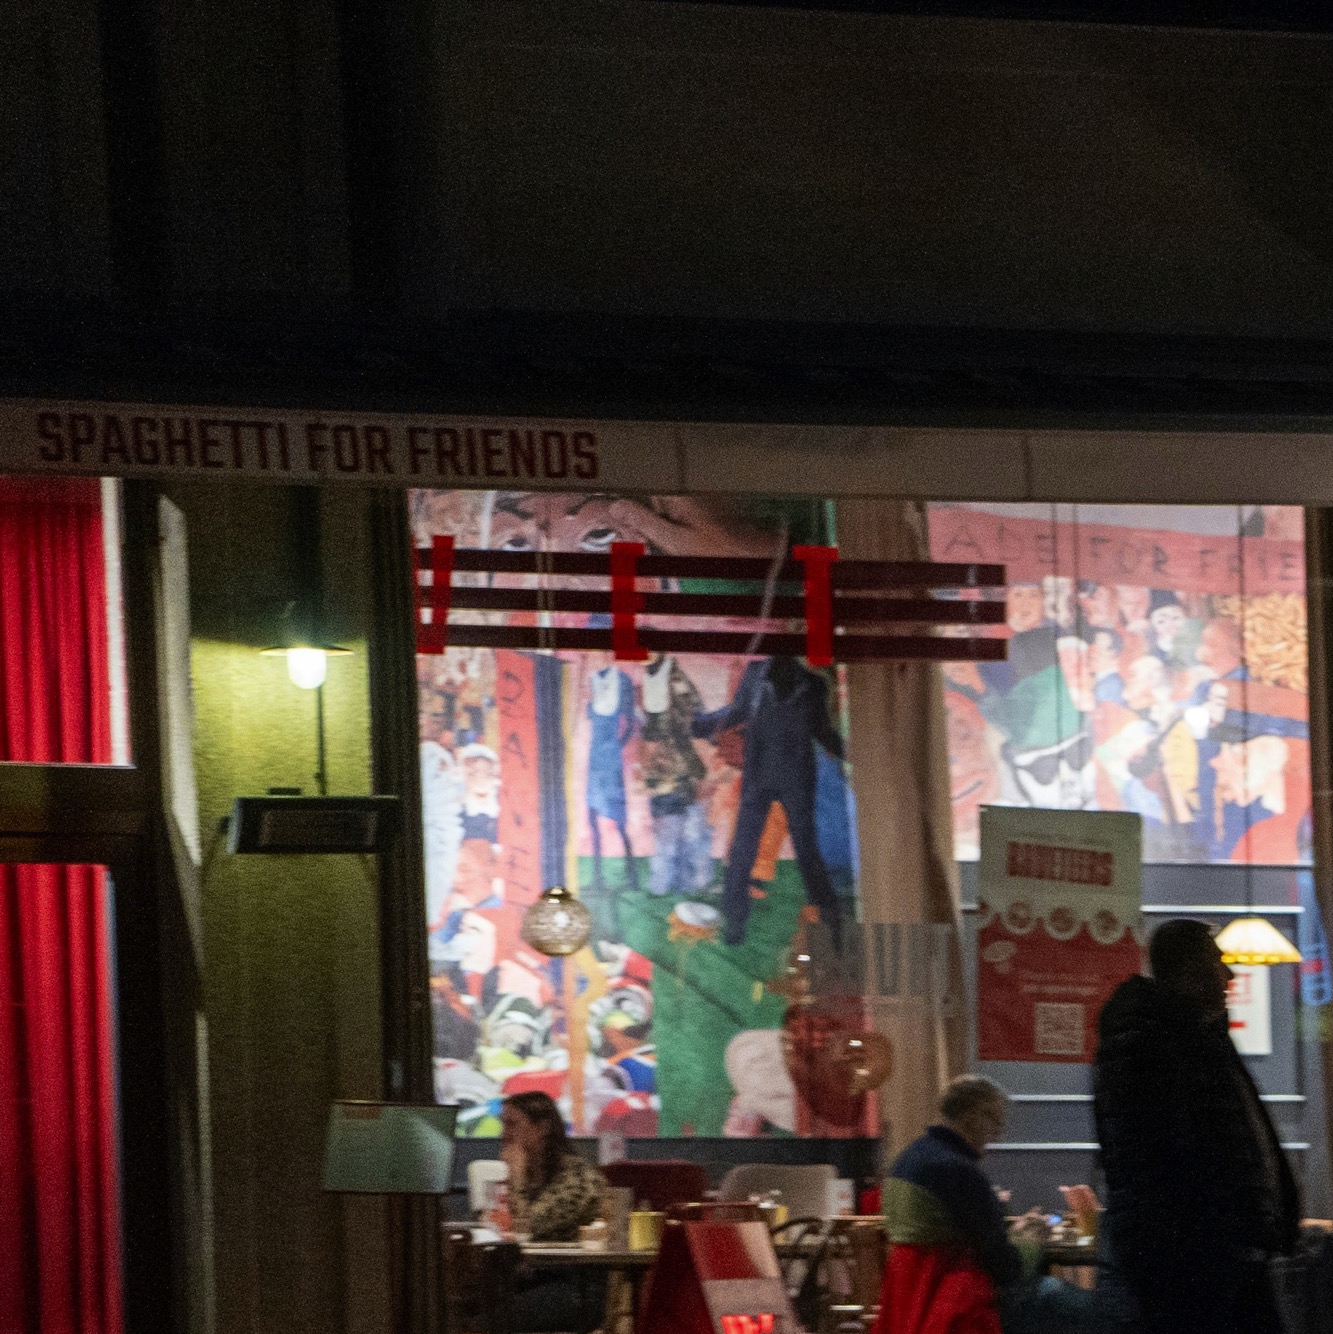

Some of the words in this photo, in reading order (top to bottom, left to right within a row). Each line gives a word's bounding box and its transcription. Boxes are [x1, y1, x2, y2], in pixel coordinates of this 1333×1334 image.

[37, 412, 290, 472] SPAGHETTI
[305, 420, 392, 474] FOR
[409, 426, 600, 481] FRIENDS
